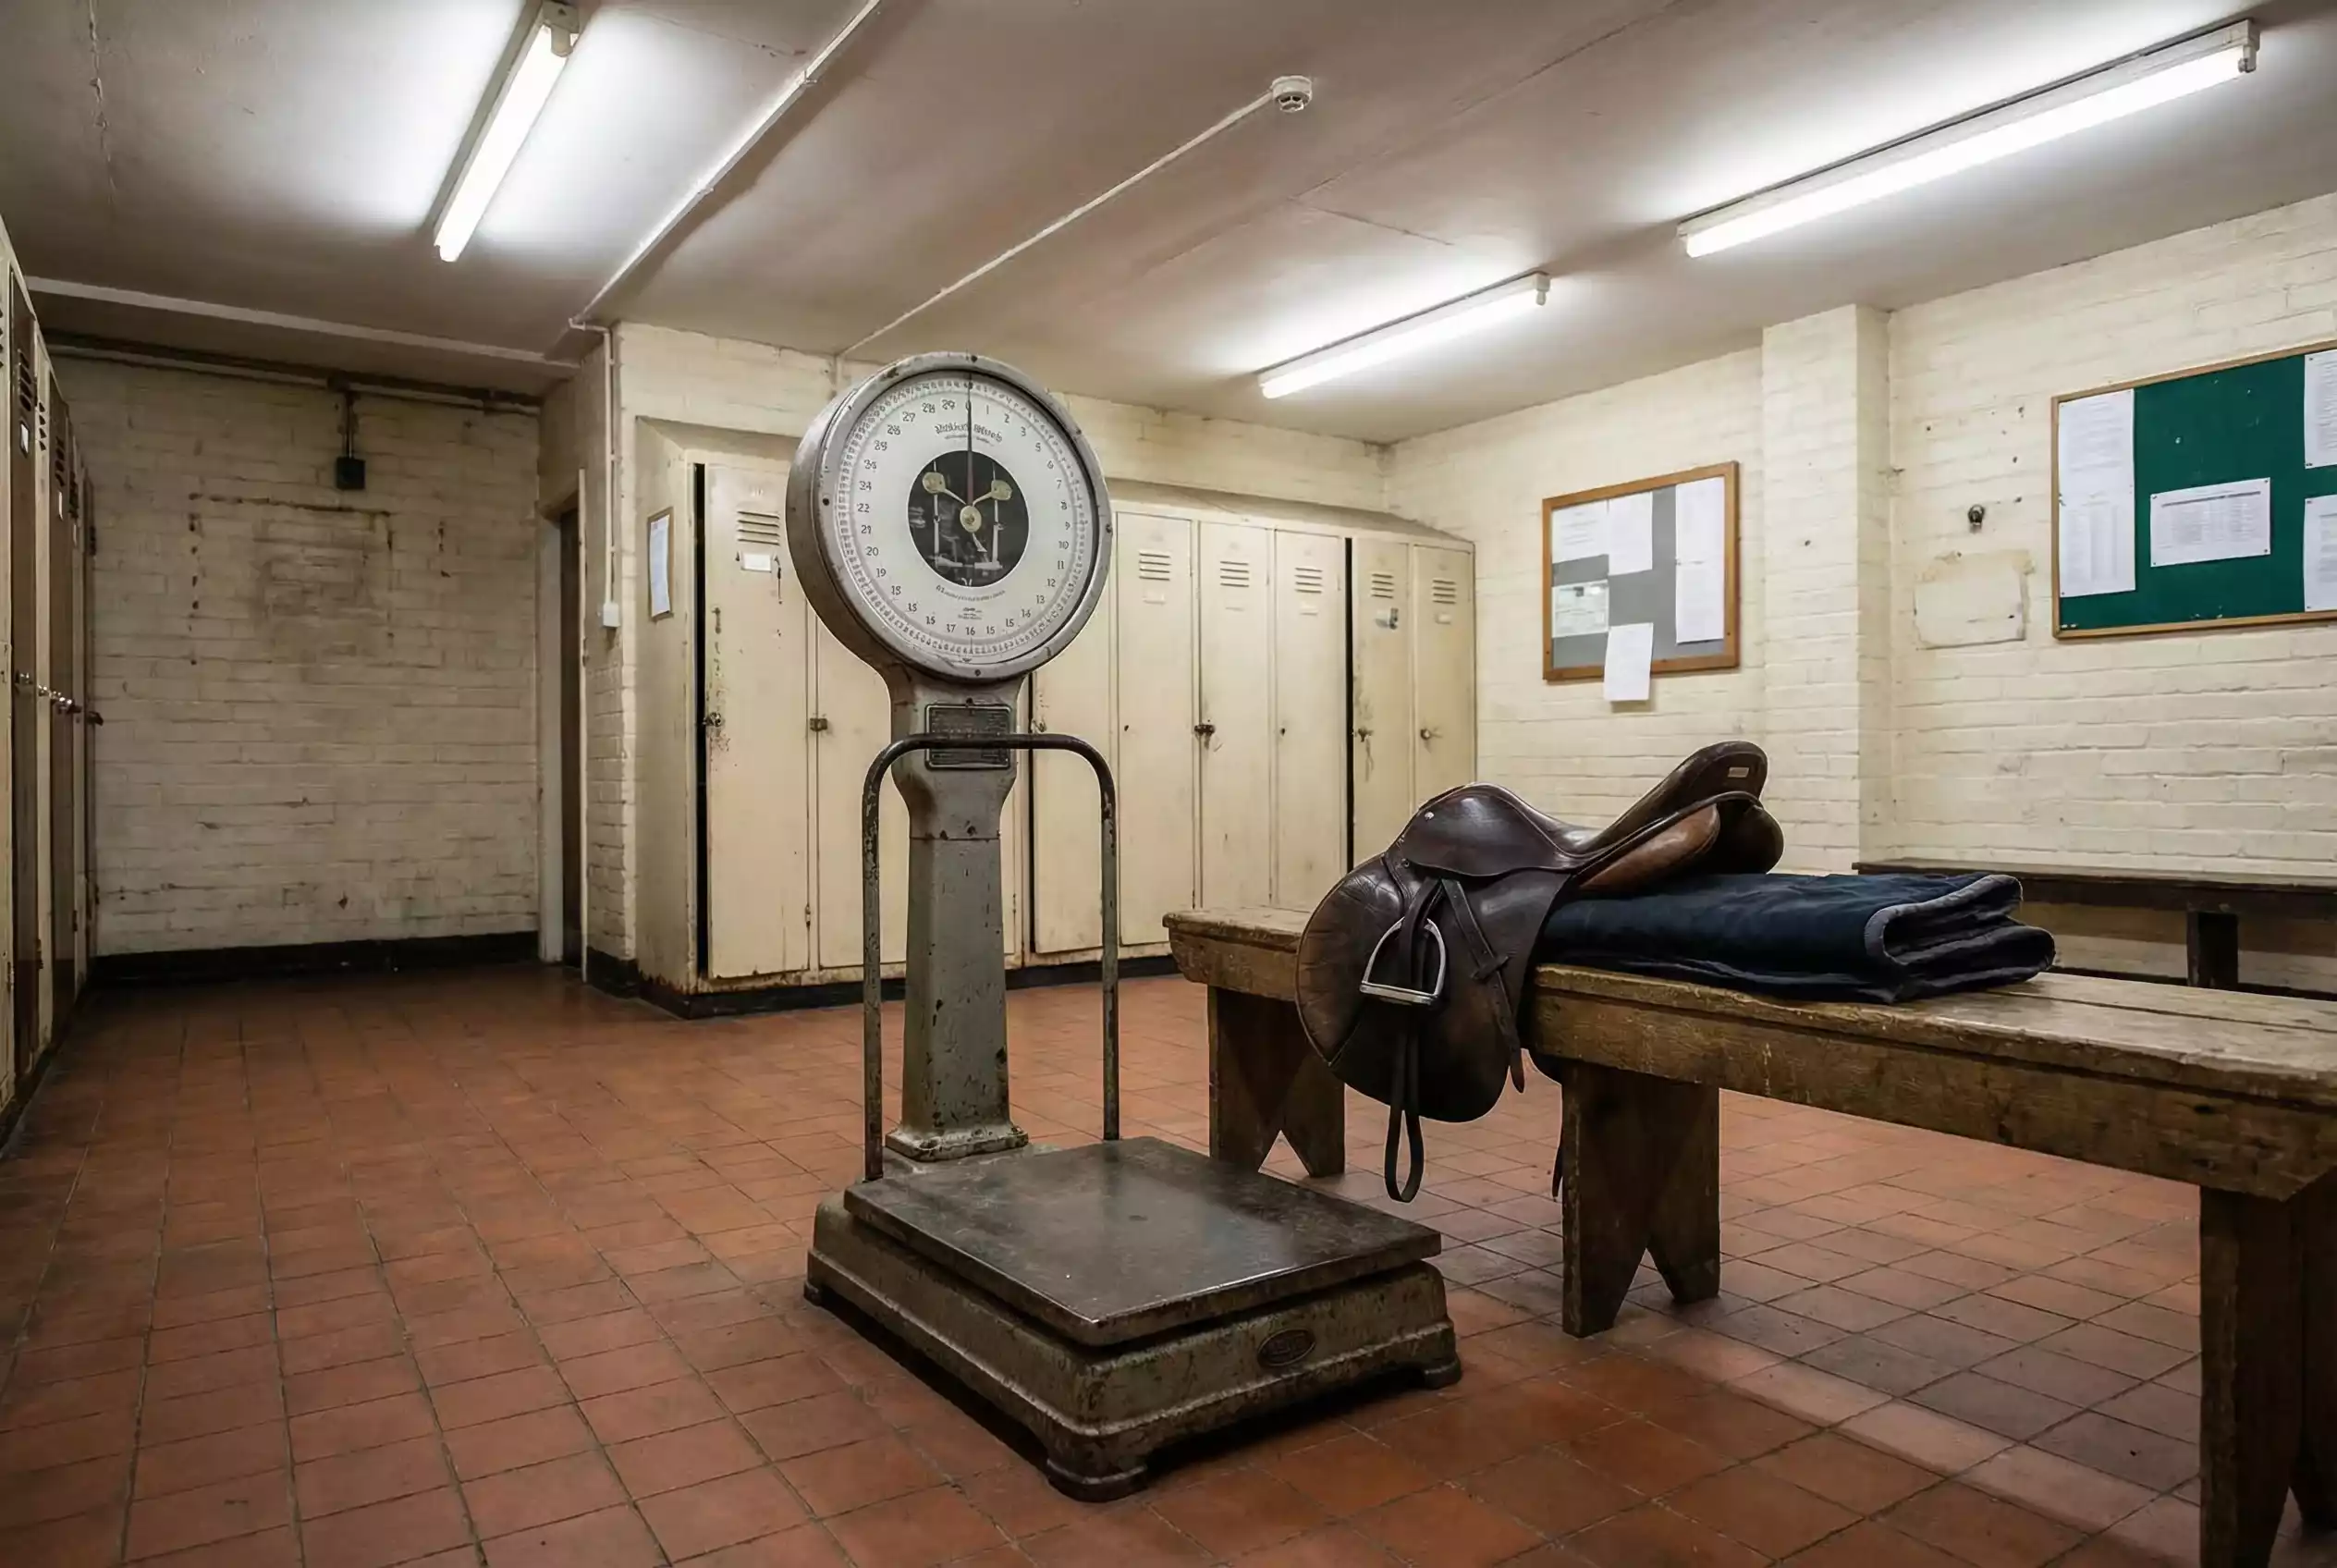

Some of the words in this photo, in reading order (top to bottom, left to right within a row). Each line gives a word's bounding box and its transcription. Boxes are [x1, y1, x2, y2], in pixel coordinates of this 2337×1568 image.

[1004, 413, 1010, 423] 2
[1021, 427, 1027, 437] 3
[1056, 480, 1062, 489] 7
[1065, 521, 1071, 531] 9
[1058, 541, 1069, 549] 10
[866, 546, 878, 556] 20
[1058, 560, 1065, 570] 11
[876, 568, 887, 577] 19
[1046, 579, 1056, 587] 12
[1036, 594, 1046, 604] 13
[1006, 619, 1015, 628] 15
[946, 624, 956, 633] 17
[965, 627, 975, 636] 16
[986, 626, 996, 634] 15
